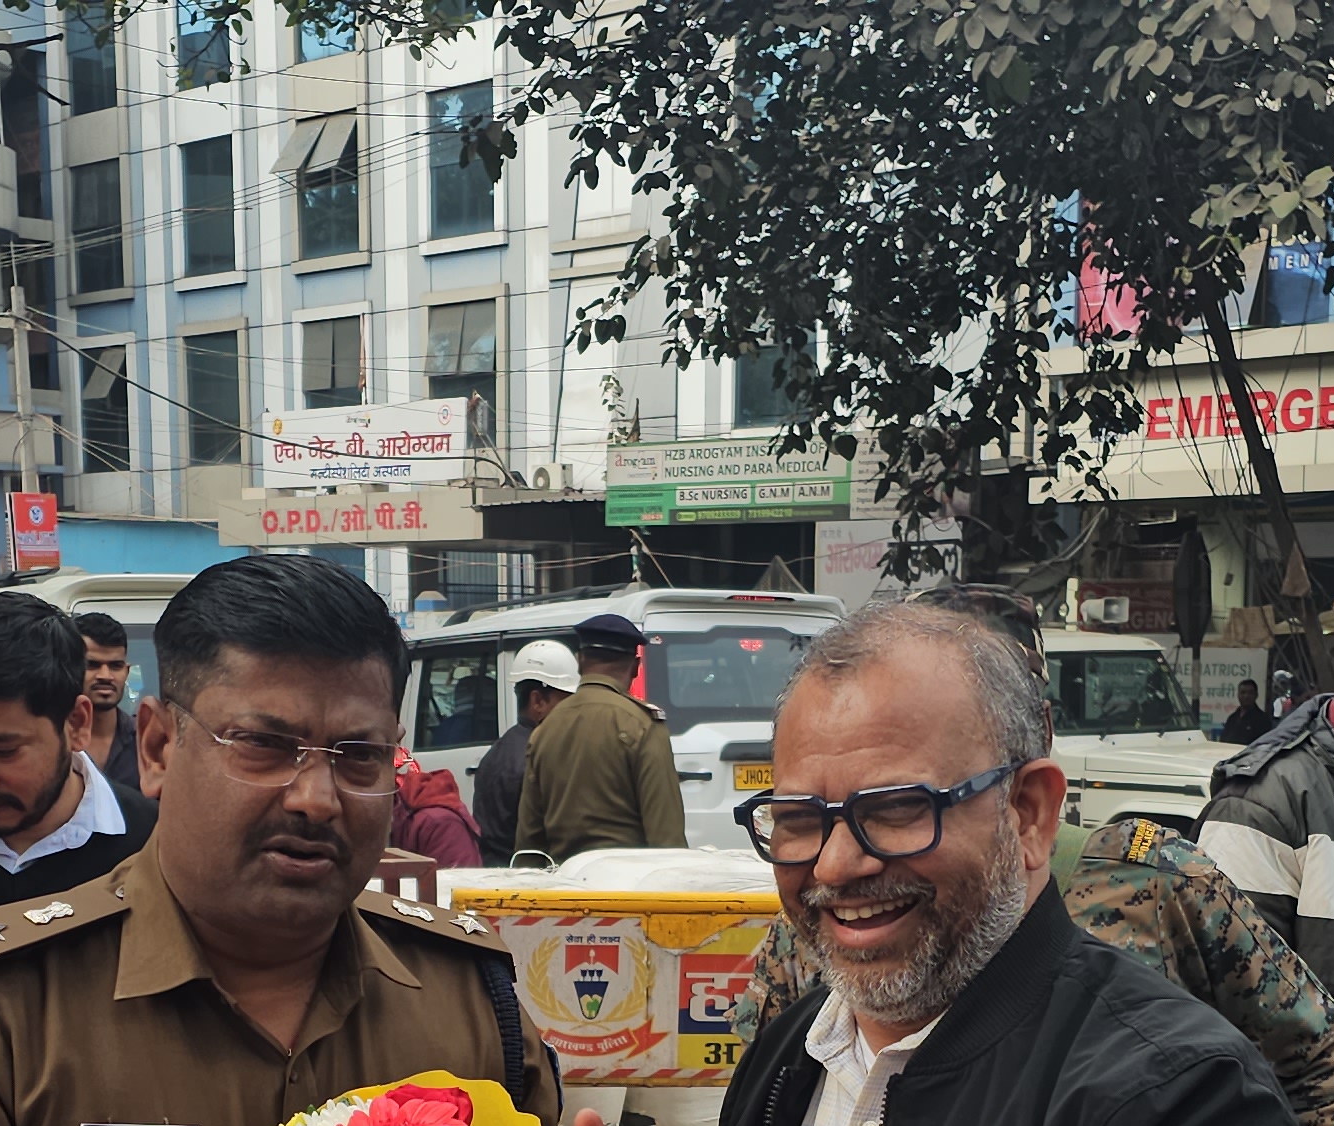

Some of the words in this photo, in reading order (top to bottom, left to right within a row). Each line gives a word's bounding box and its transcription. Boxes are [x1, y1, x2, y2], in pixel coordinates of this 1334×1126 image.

[345, 431, 370, 457] बी.
[376, 430, 452, 458] आरोग्यम
[664, 448, 686, 461] HZB
[688, 446, 744, 460] AROGYAM
[664, 464, 715, 479] NURSING
[716, 463, 741, 477] AND
[743, 461, 774, 475] PARA
[776, 458, 828, 474] MEDICAL
[701, 489, 749, 501] NURSING
